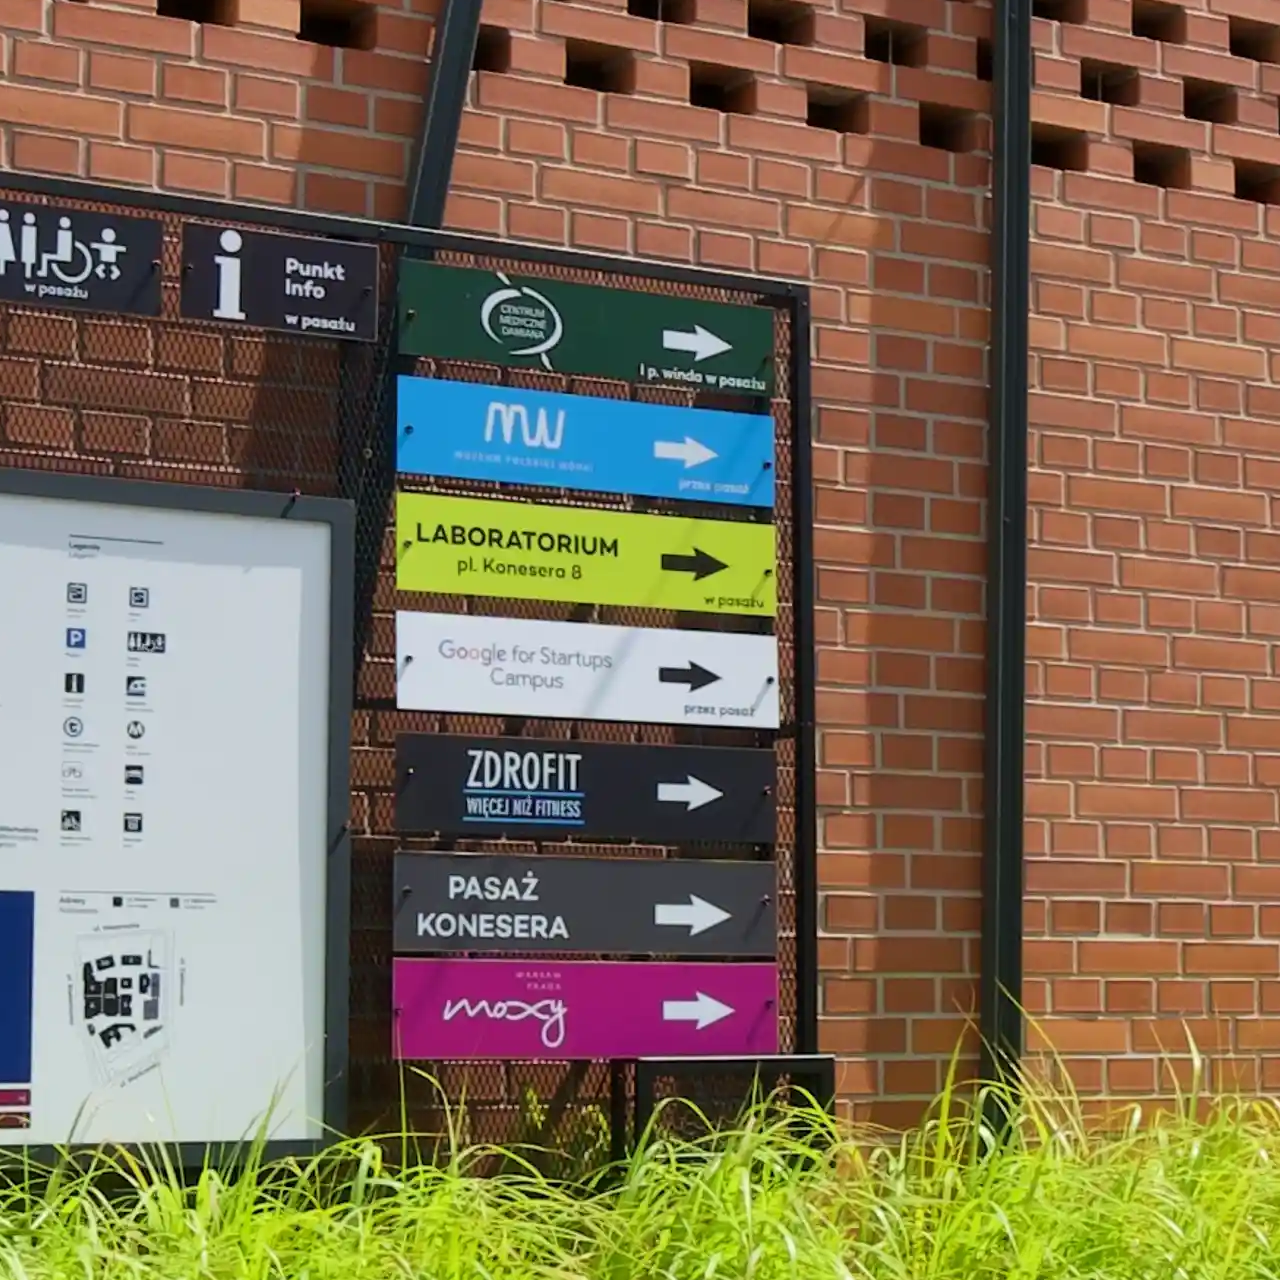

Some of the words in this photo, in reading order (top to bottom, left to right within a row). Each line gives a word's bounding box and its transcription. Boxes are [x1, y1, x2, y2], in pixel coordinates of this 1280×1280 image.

[285, 257, 346, 282] Punkt
[24, 283, 37, 295] w
[38, 283, 89, 301] pasażu
[285, 278, 326, 300] Info
[285, 314, 299, 326] w
[300, 313, 356, 333] pasażu
[662, 366, 703, 383] winda
[705, 373, 718, 384] w
[719, 375, 766, 391] pasażu
[416, 523, 619, 557] LABORATORIUM
[457, 556, 477, 577] pl.
[483, 558, 567, 579] Konesera
[570, 565, 582, 580] 8
[704, 594, 716, 604] w
[717, 593, 765, 609] pasażu
[438, 639, 507, 664] Google
[511, 644, 536, 663] for
[539, 649, 613, 672] Startups
[489, 667, 565, 692] Campus
[467, 749, 582, 791] ZDROFIT
[466, 796, 510, 819] WIĘCEJ
[535, 799, 581, 818] FITNESS
[448, 870, 540, 902] PASAŻ
[417, 913, 570, 939] KONESERA
[443, 998, 568, 1048] moxy
